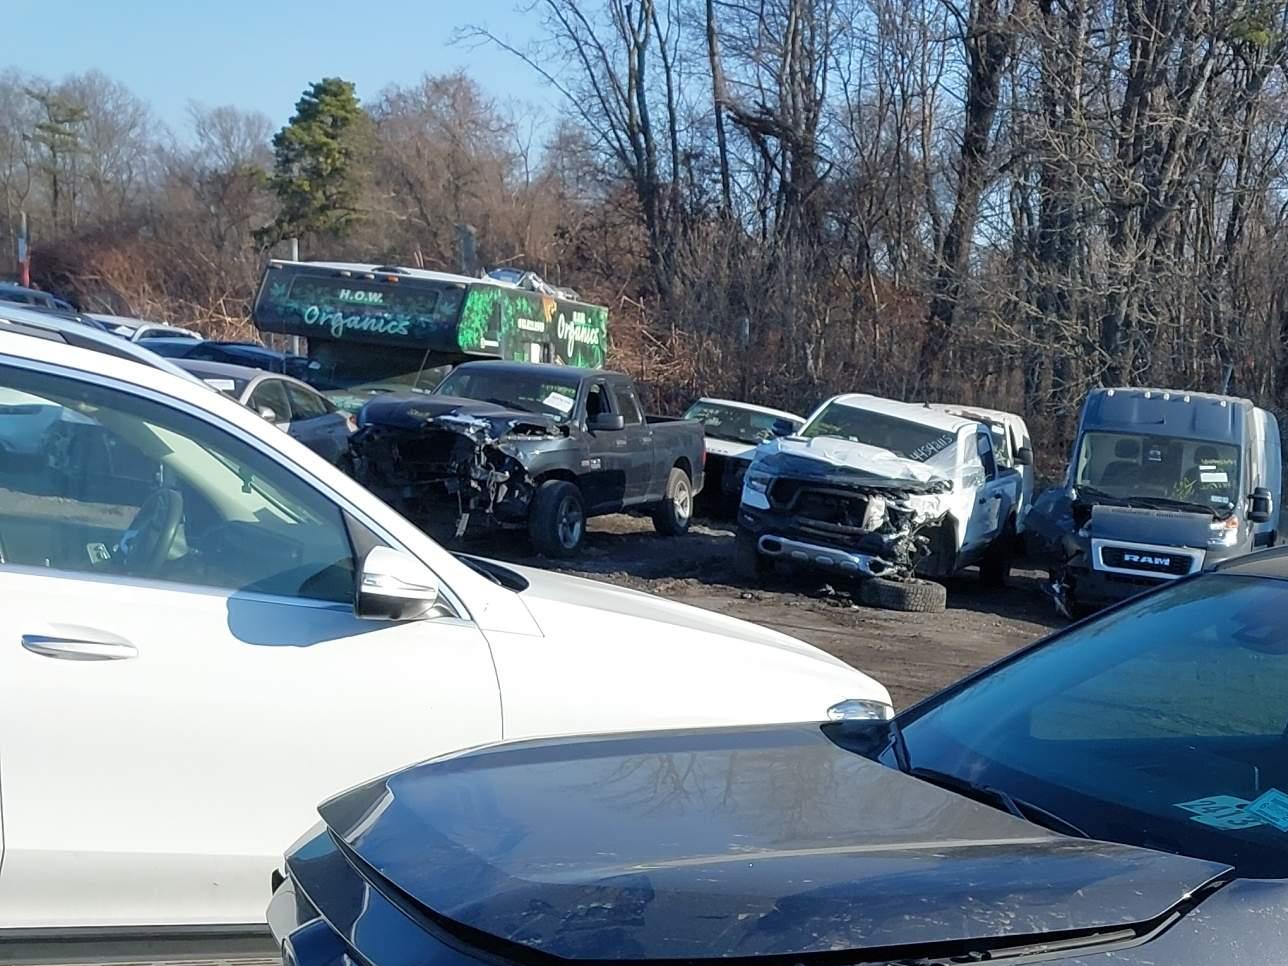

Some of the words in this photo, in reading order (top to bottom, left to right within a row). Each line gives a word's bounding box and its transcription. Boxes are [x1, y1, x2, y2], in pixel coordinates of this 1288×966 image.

[338, 289, 383, 303] H.O.W.
[304, 305, 409, 338] Organics
[557, 312, 600, 358] Organics
[1124, 553, 1170, 566] RAM
